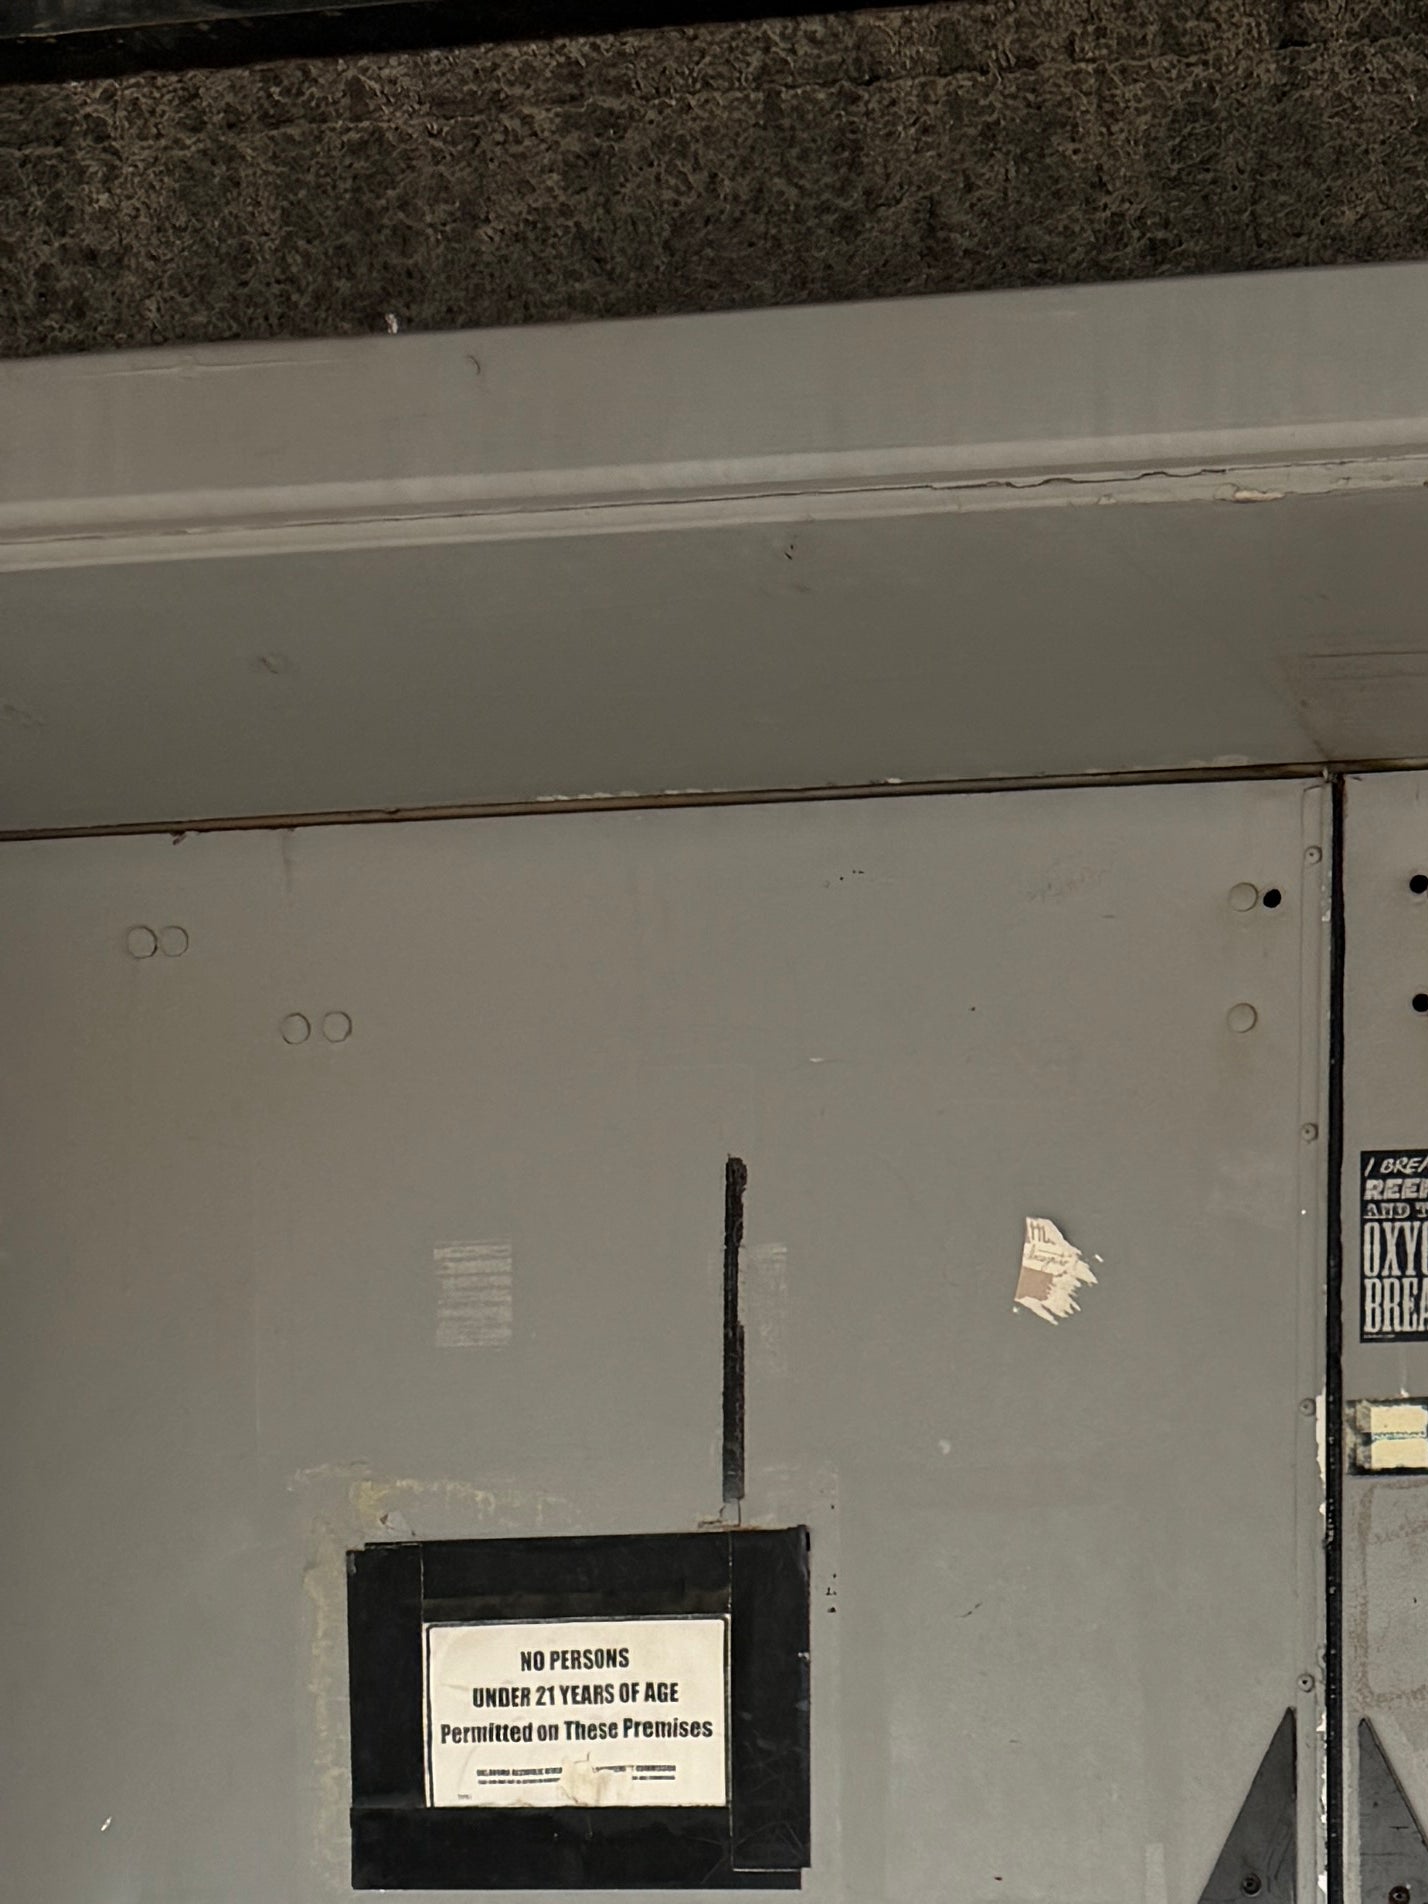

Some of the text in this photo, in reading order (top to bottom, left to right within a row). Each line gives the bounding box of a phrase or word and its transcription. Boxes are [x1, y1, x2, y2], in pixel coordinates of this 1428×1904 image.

[1364, 1156, 1375, 1177] I
[1363, 1201, 1411, 1219] AND
[520, 1648, 629, 1671] NO PERSONS
[473, 1682, 679, 1708] UNDER 21 YEARS OF AGE
[441, 1717, 713, 1744] Permitted on These Premises
